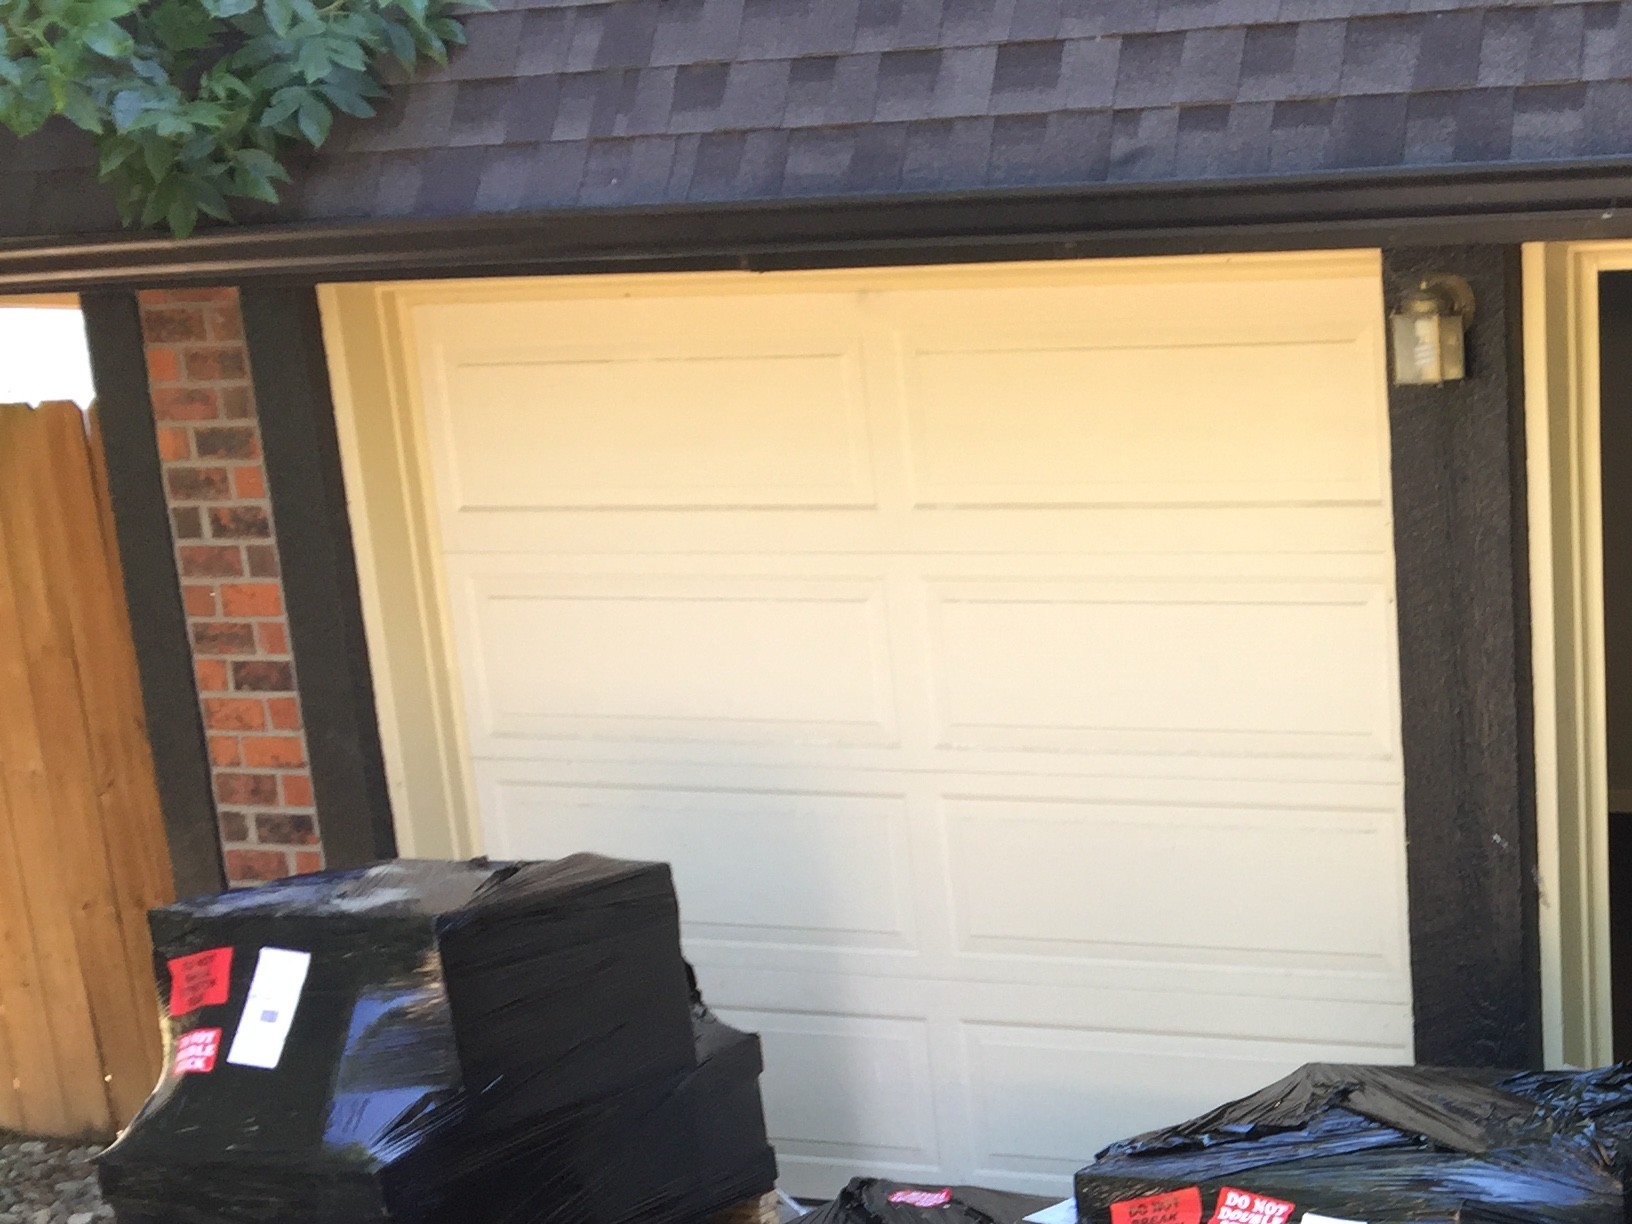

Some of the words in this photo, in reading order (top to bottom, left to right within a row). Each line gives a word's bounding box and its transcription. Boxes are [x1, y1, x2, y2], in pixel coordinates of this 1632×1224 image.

[1128, 1203, 1148, 1217] DO
[1225, 1191, 1251, 1209] DO
[1252, 1198, 1288, 1217] NOT
